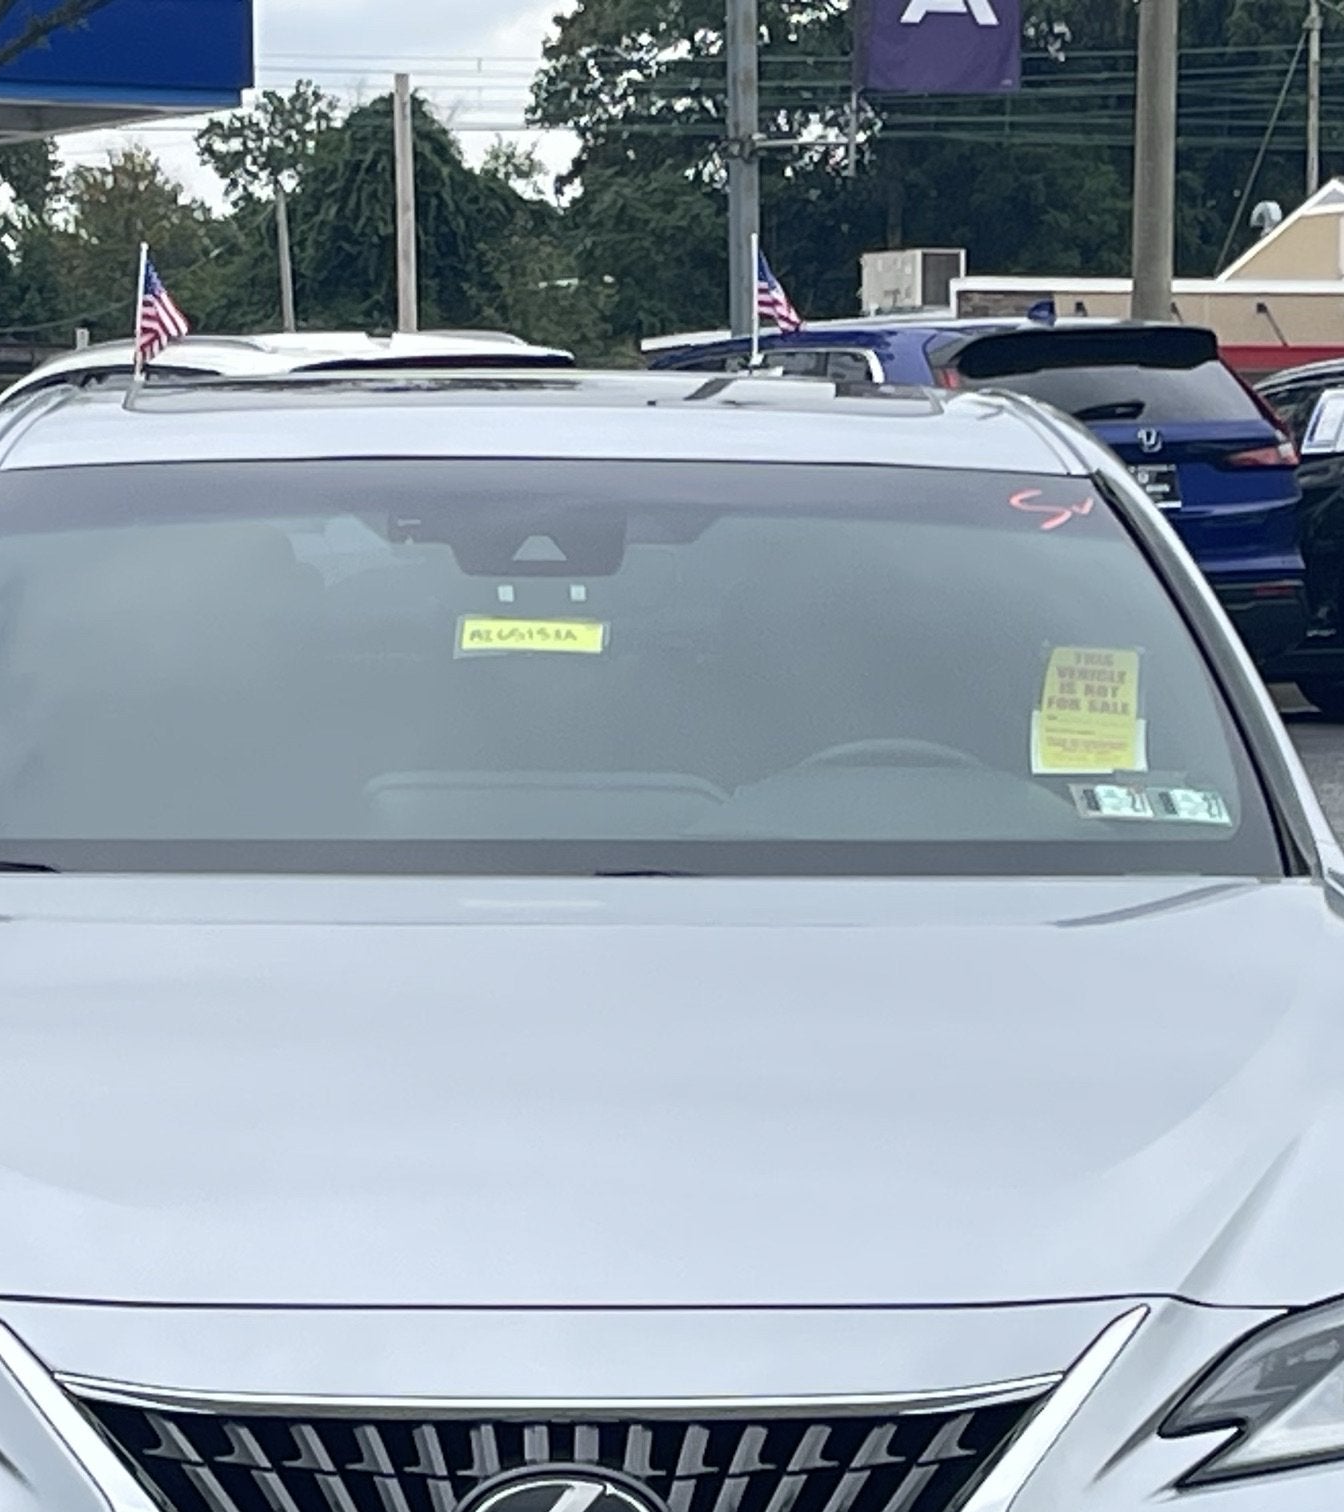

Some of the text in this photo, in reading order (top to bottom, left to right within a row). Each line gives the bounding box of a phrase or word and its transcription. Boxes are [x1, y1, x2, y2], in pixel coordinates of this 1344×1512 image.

[1056, 666, 1128, 684] VEHICLE
[1084, 683, 1119, 699] NOT
[1046, 696, 1130, 716] FOR SALE
